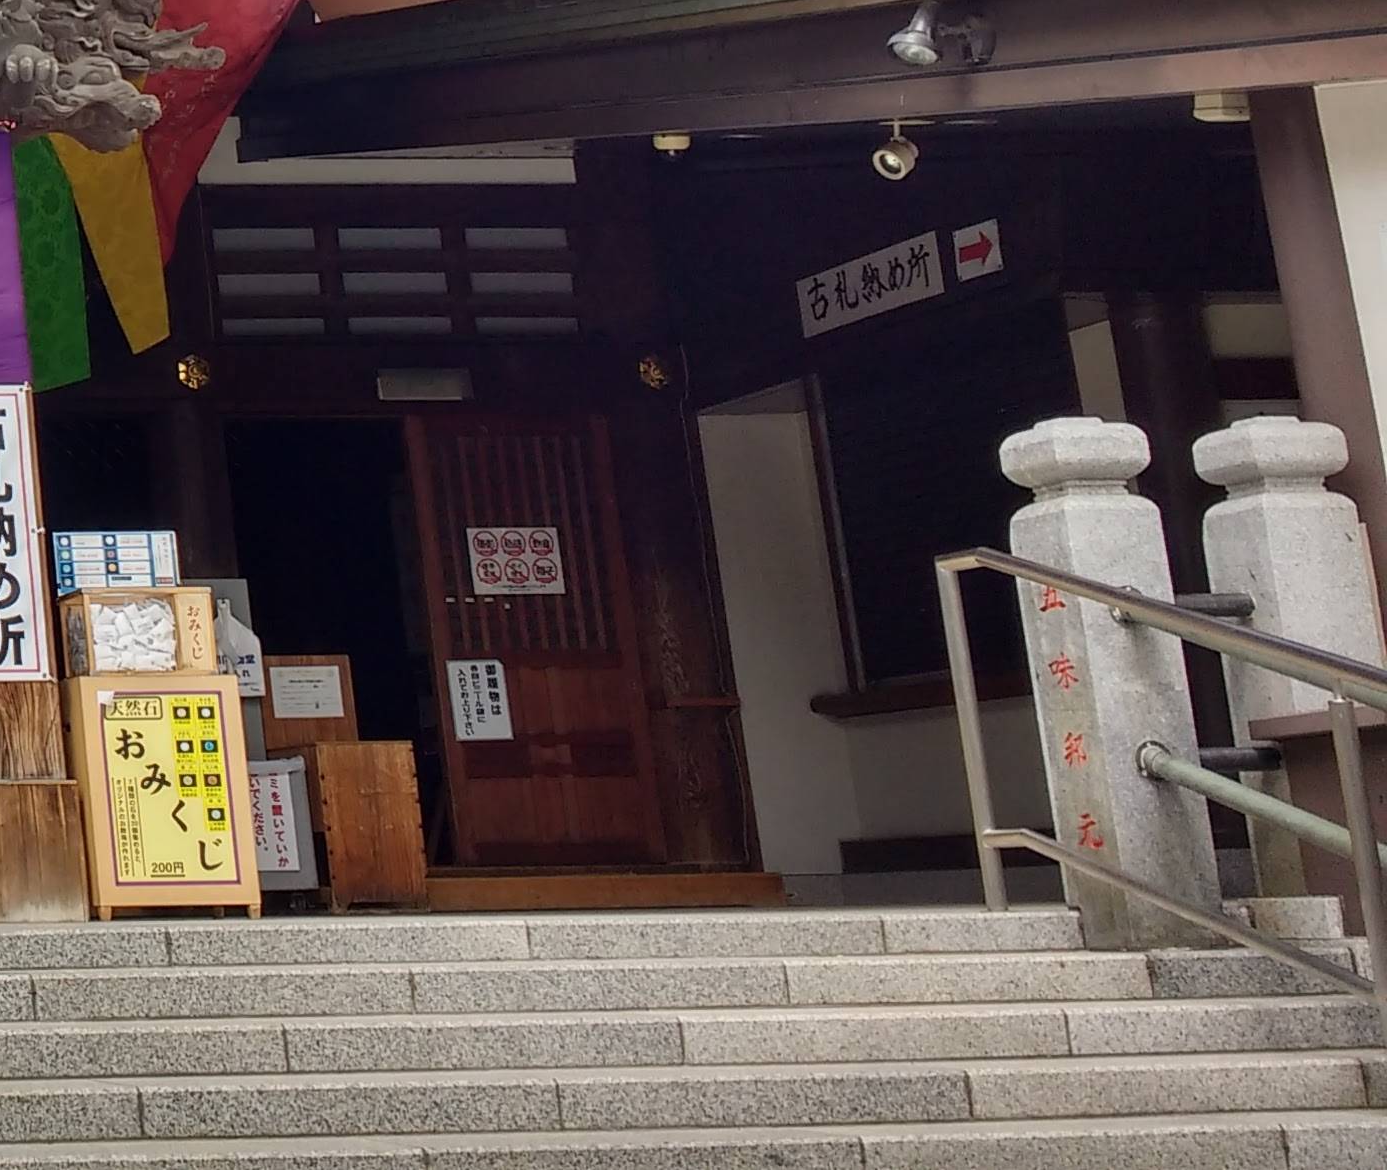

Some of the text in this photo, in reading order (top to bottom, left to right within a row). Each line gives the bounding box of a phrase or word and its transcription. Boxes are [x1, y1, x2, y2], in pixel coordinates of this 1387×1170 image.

[807, 243, 930, 320] 古札納め所
[186, 606, 204, 660] おみくじ
[110, 700, 158, 717] 天然石
[115, 728, 223, 870] おみくじ
[151, 861, 185, 874] 200円
